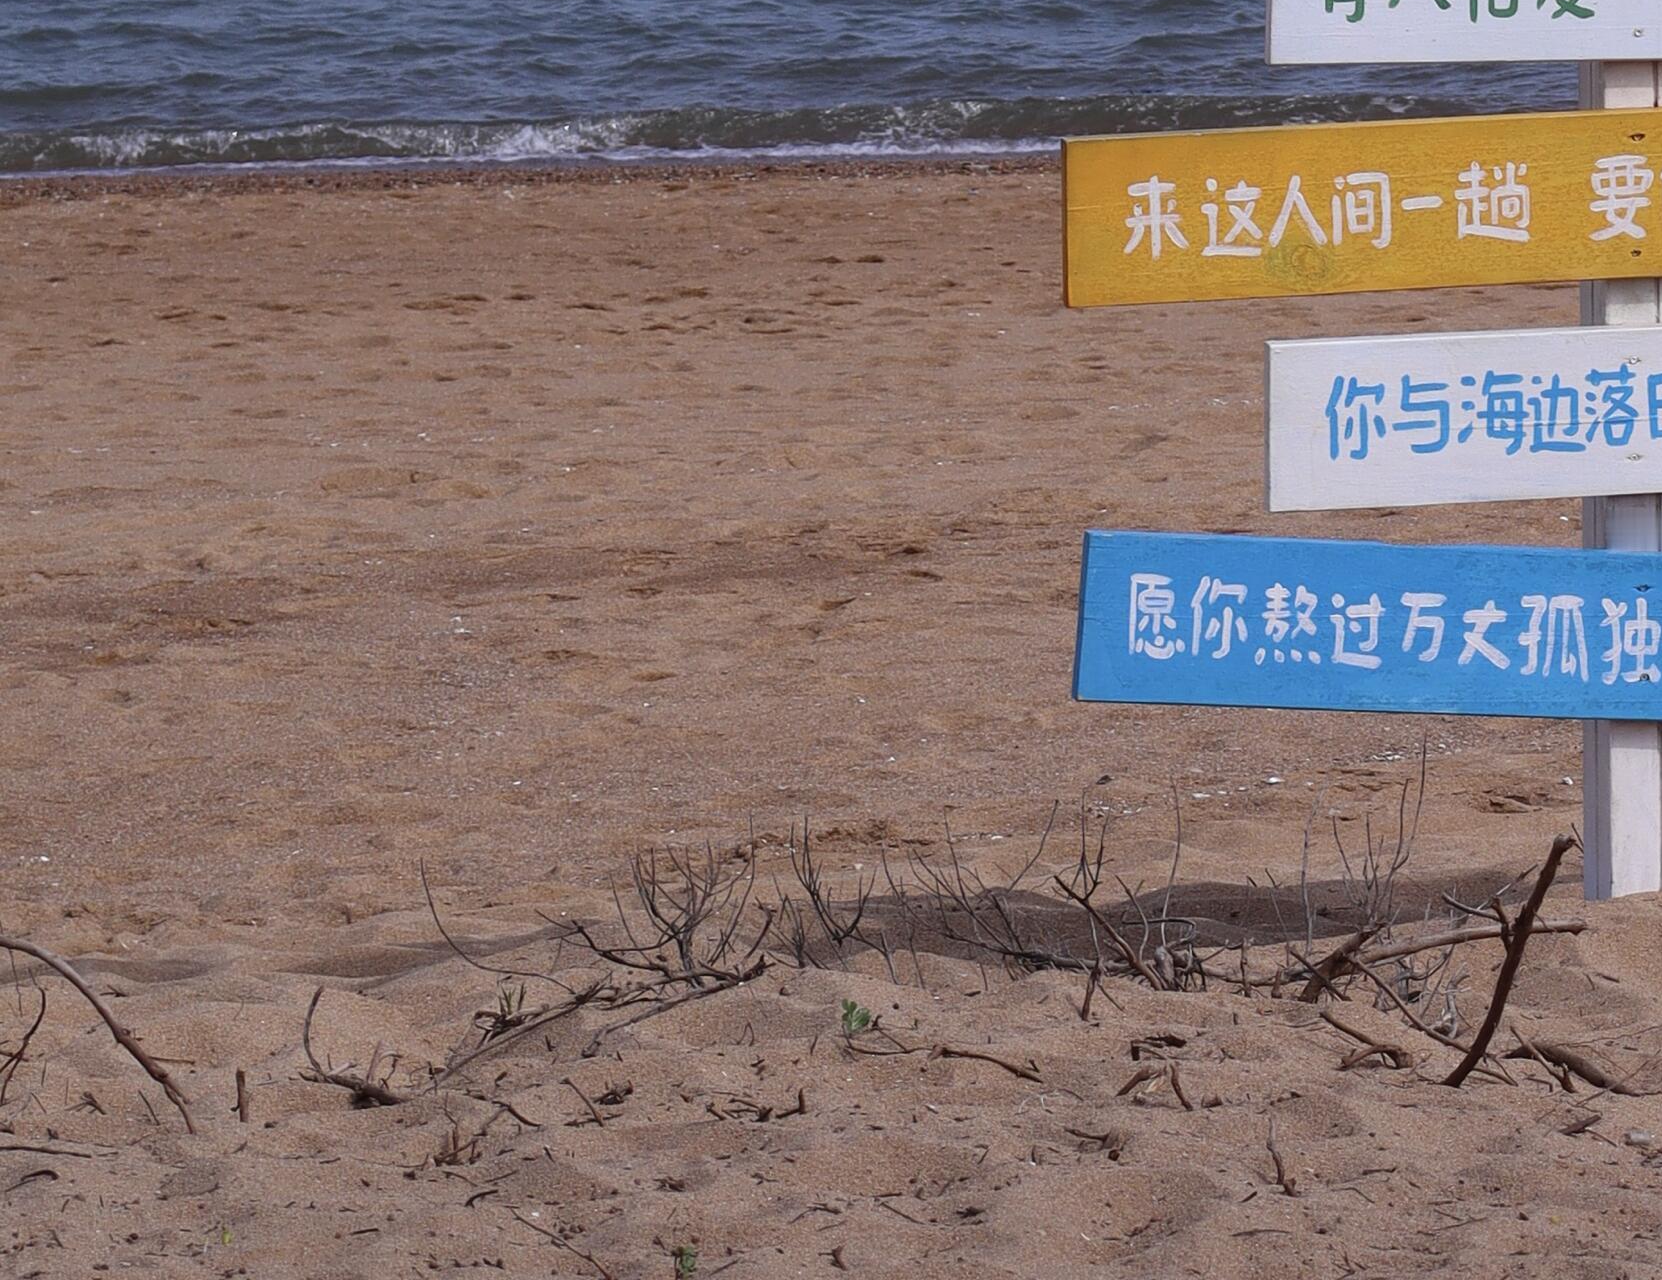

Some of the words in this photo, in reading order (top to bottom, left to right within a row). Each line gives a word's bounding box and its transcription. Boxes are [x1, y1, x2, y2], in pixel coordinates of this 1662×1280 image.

[1123, 160, 1532, 260] 来这人间一趟
[1127, 571, 1662, 686] 愿你熬过万丈孤独
